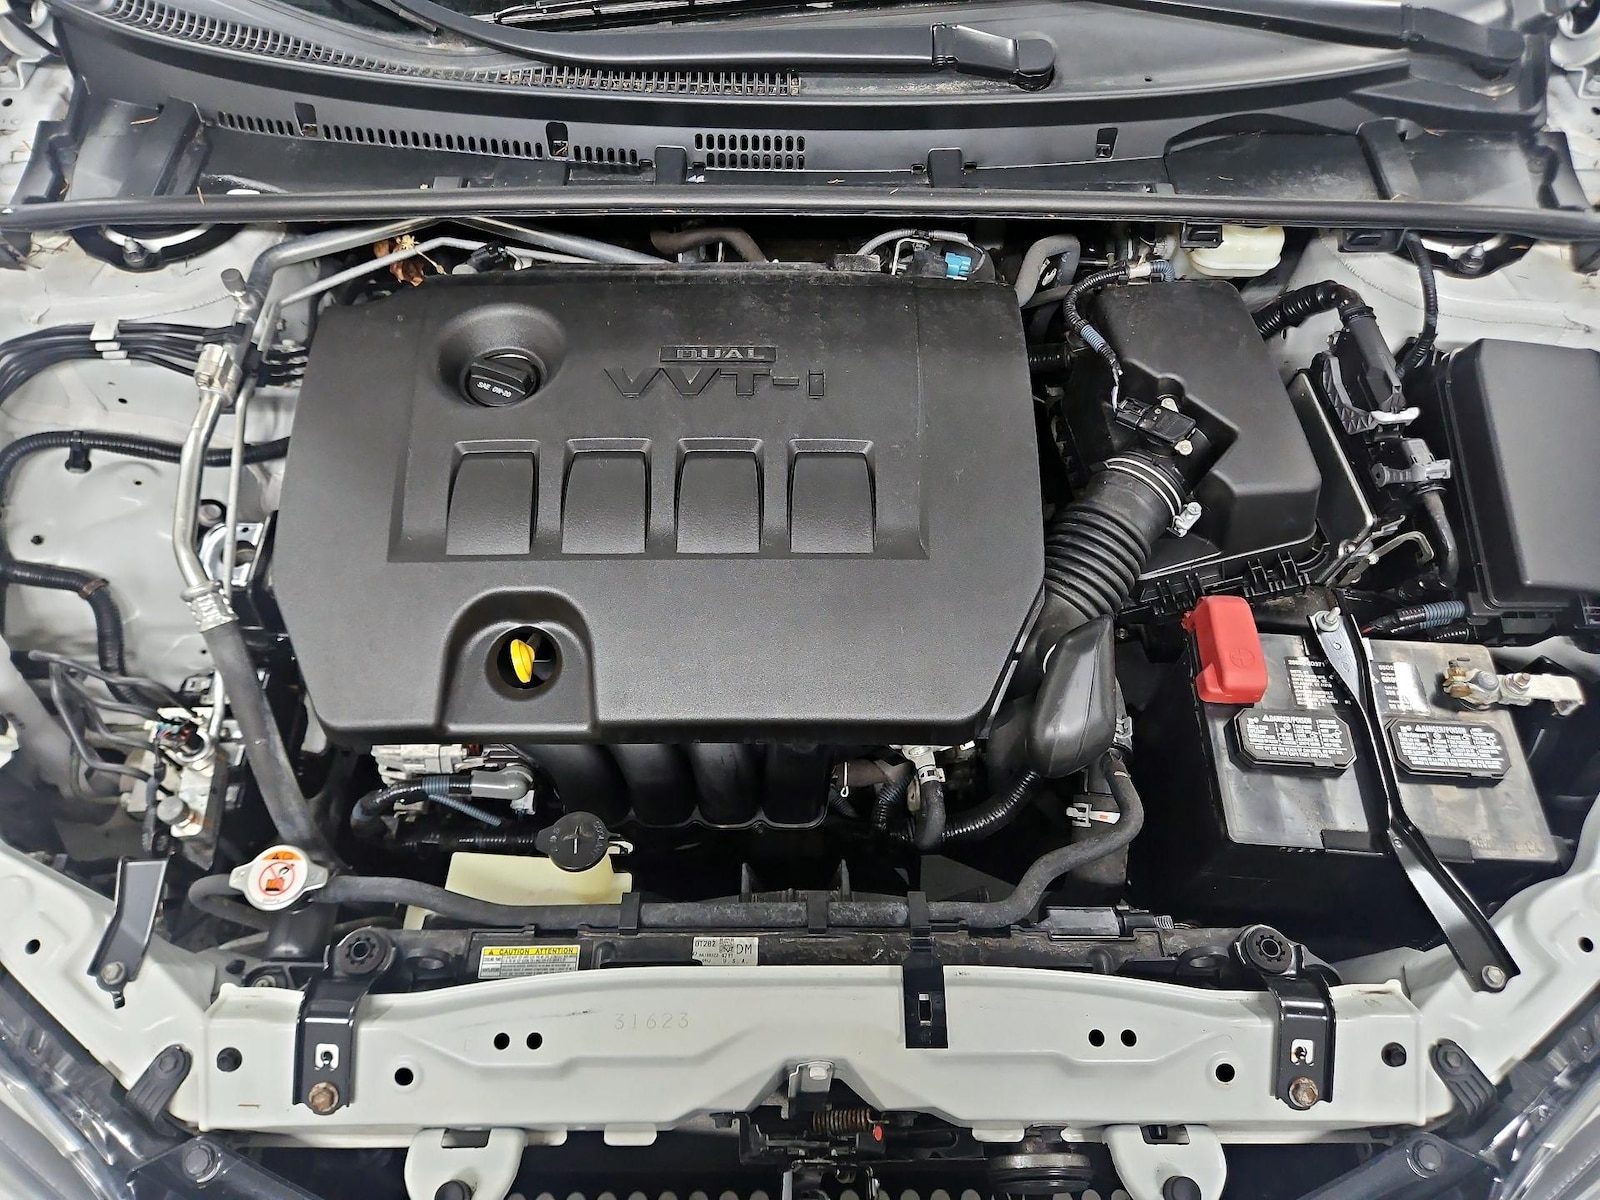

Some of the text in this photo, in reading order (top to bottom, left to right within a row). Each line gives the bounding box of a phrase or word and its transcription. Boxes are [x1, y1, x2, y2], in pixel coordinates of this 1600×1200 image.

[676, 349, 765, 359] DUAL
[477, 381, 512, 397] SAE 0W-20
[535, 947, 574, 955] ATTENTION
[736, 943, 752, 955] DM
[614, 1011, 689, 1031] 31623
